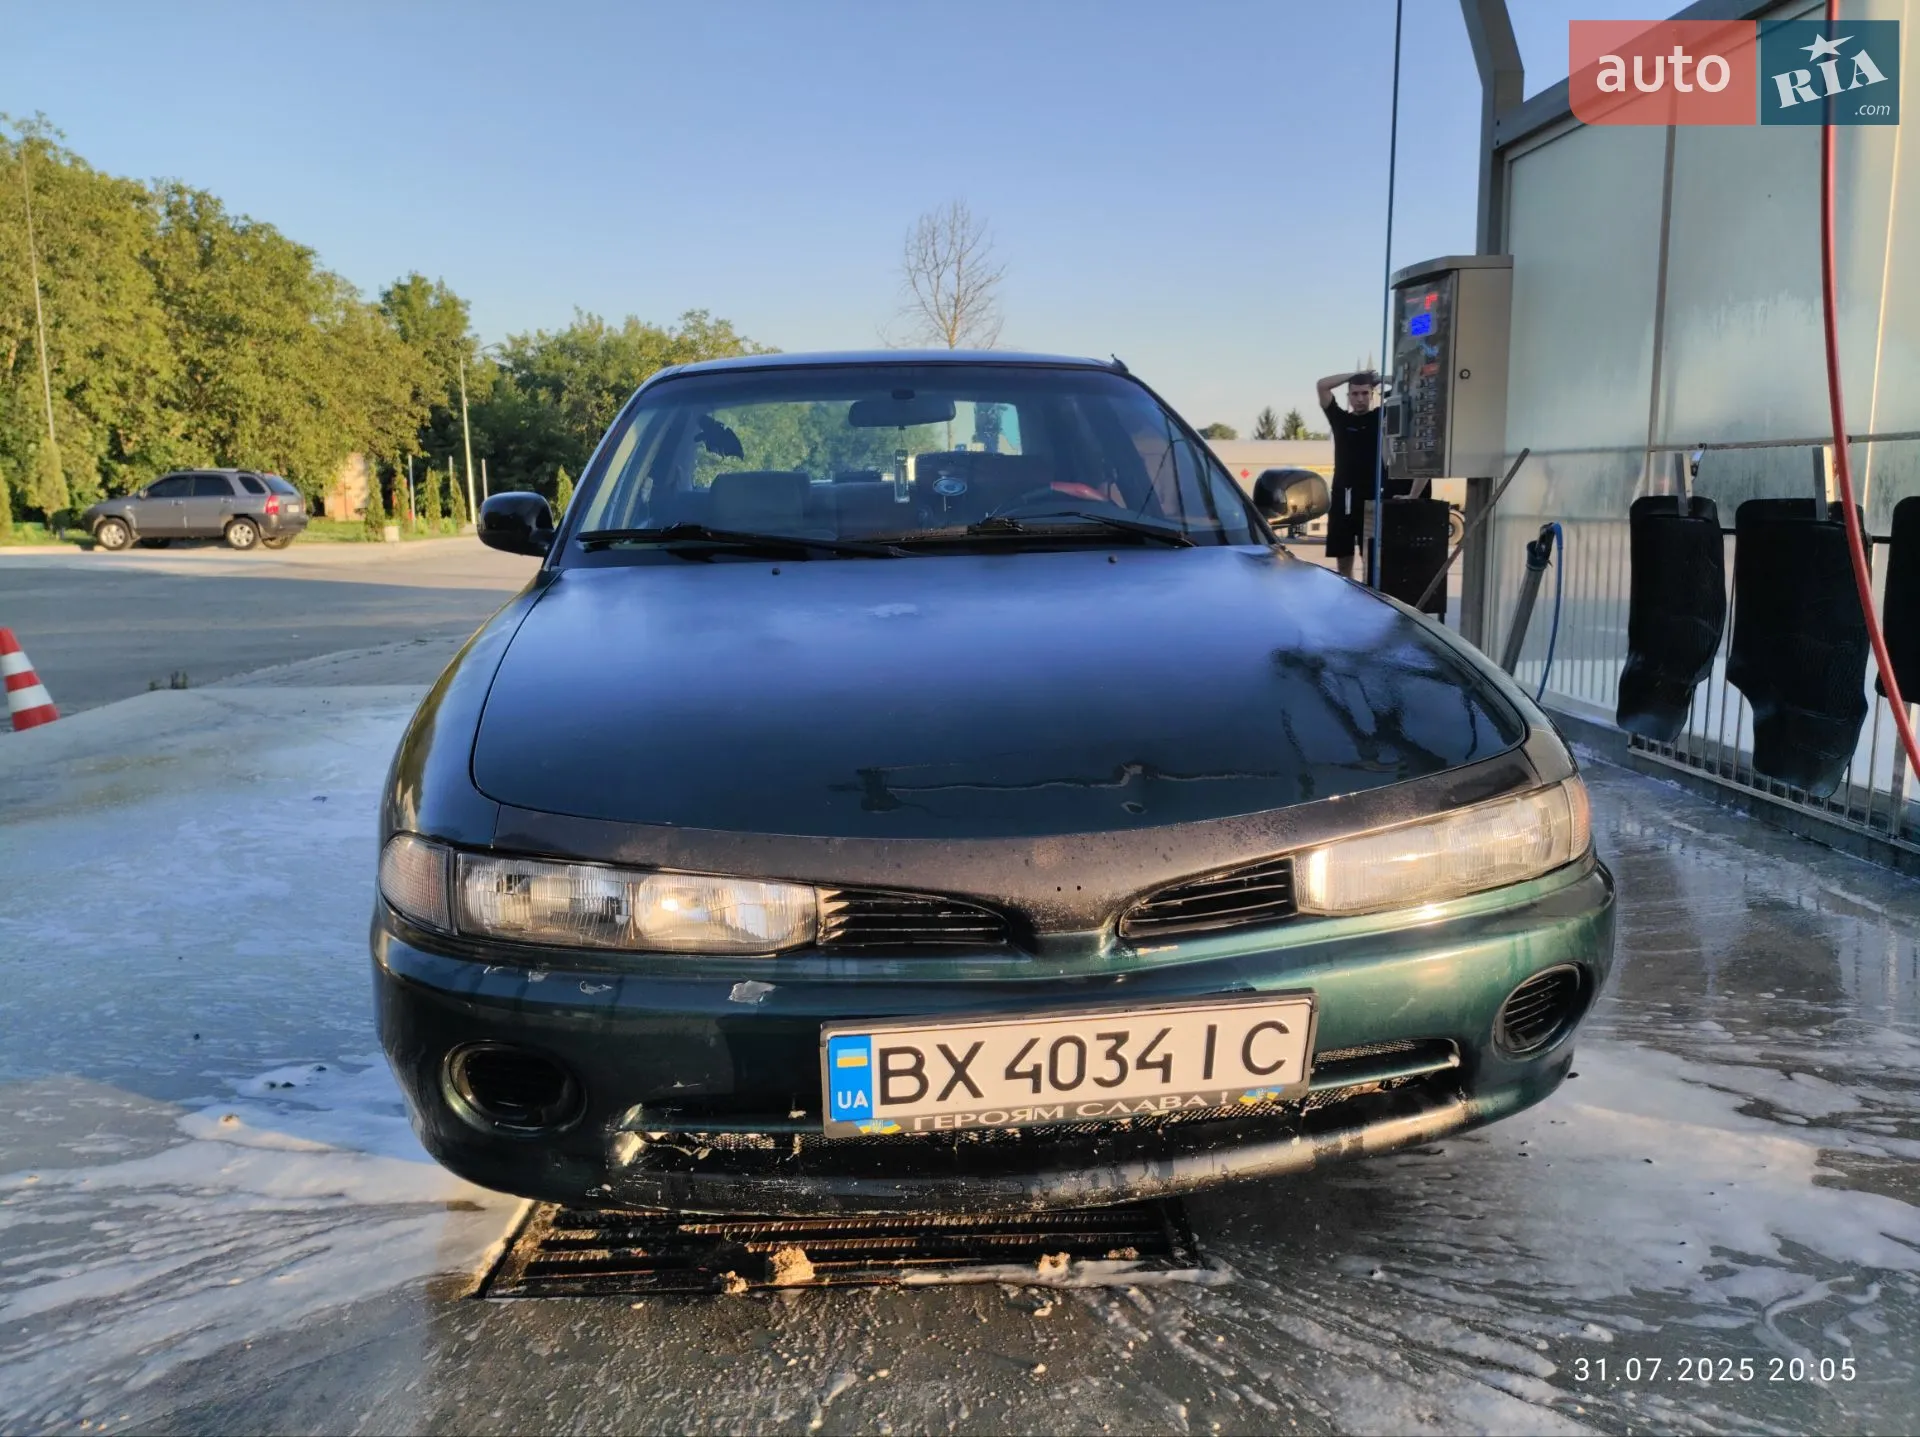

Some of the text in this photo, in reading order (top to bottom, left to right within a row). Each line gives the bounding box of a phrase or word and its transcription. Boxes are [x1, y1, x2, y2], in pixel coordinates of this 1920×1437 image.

[879, 1020, 1291, 1107] BX 4034 IC
[837, 1090, 869, 1109] UA
[913, 1104, 1064, 1131] ГЕРОЯМ
[1076, 1094, 1208, 1117] СЛАВА
